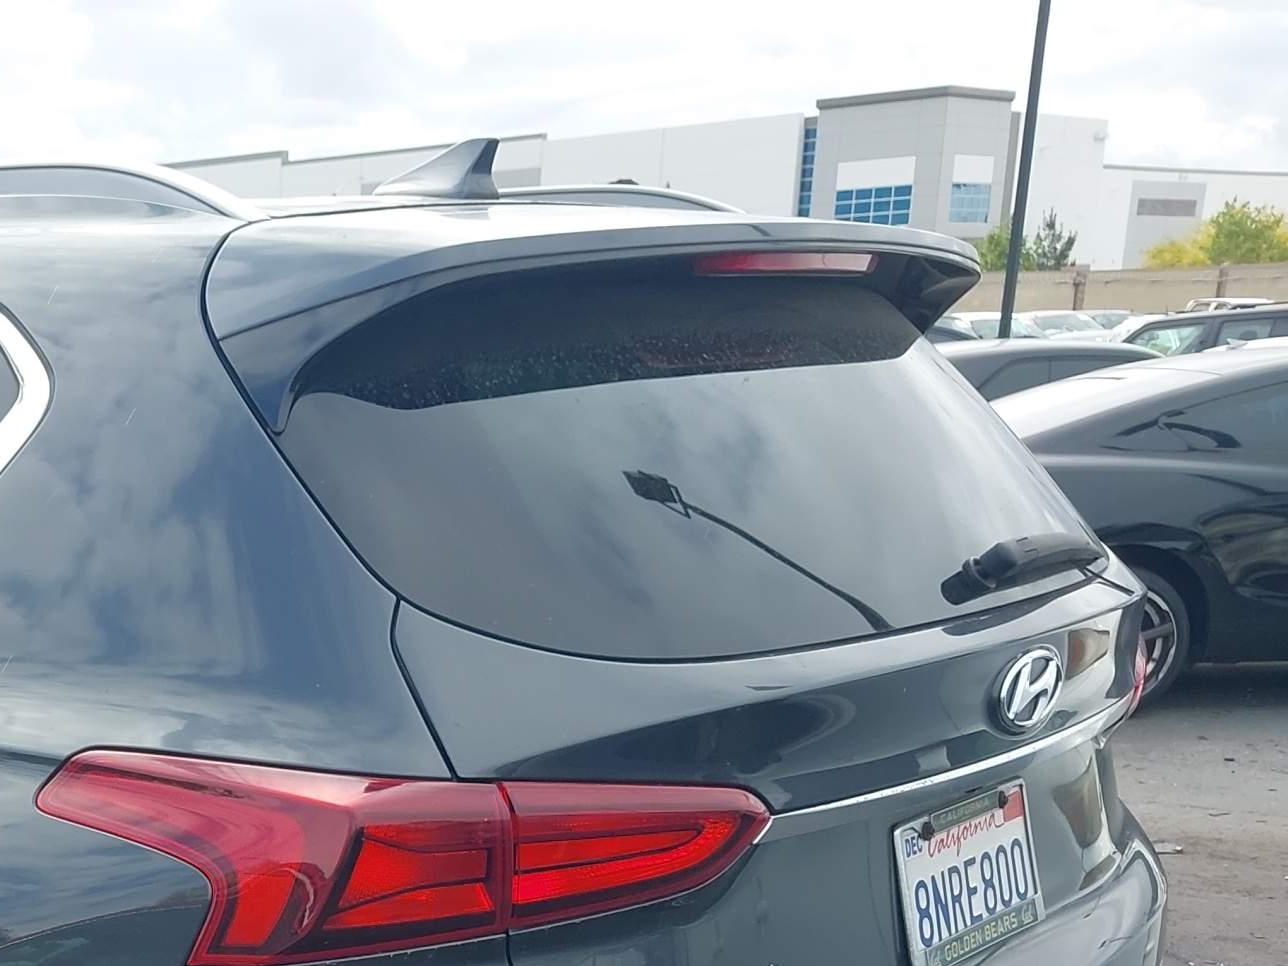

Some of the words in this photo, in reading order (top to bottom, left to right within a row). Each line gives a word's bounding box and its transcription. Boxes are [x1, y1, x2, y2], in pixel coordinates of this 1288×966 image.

[905, 832, 923, 858] DEC
[927, 811, 1005, 858] California
[914, 837, 1029, 948] 8NRE800
[944, 928, 984, 961] GOLDEN
[983, 912, 1018, 942] BEARS
